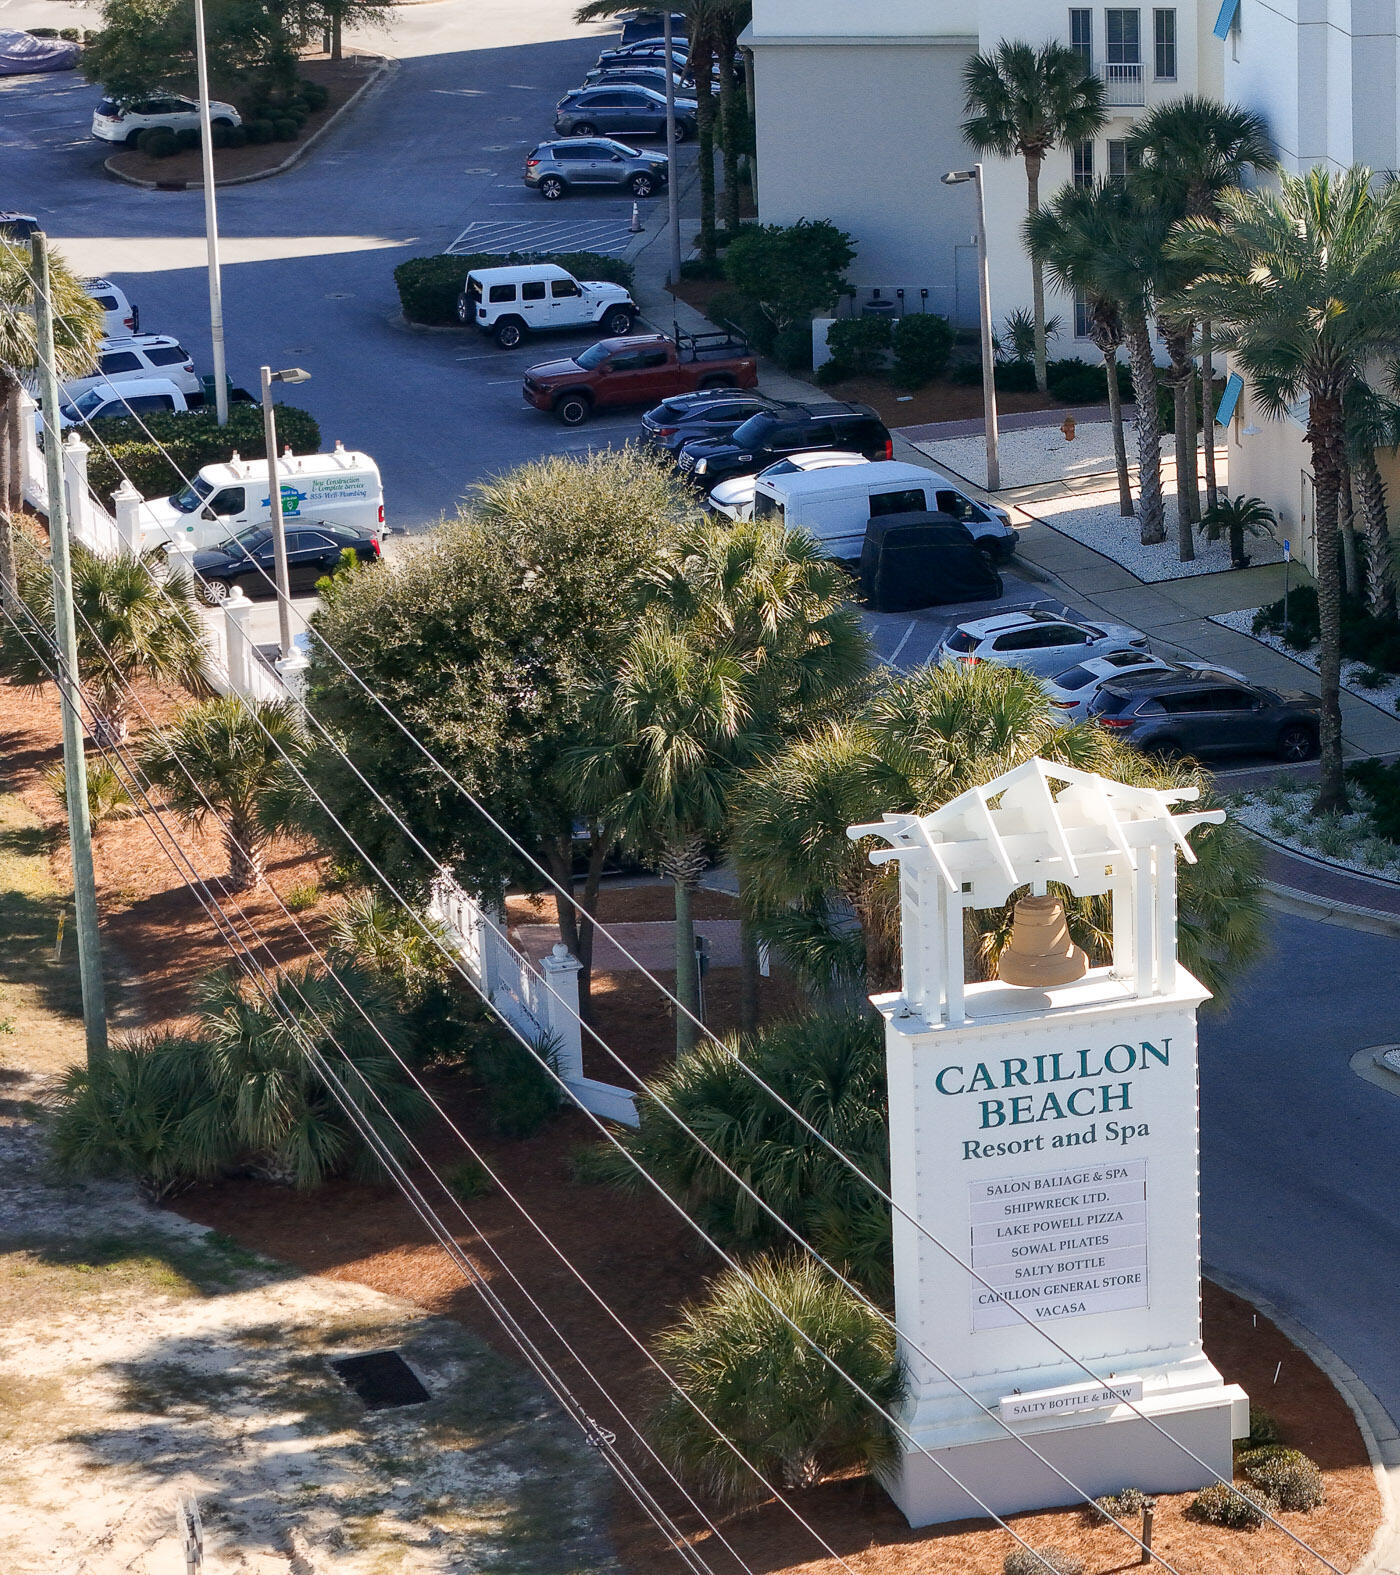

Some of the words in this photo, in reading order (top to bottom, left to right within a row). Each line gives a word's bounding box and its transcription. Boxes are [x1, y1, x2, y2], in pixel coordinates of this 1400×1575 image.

[935, 1038, 1172, 1096] CARILLON
[978, 1081, 1133, 1130] BEACH
[962, 1134, 1044, 1160] Resort
[1051, 1123, 1096, 1149] and
[1105, 1121, 1150, 1146] Spa
[987, 1180, 1031, 1195] SALON
[1034, 1173, 1090, 1190] BALIAGE
[1092, 1171, 1103, 1182] &
[1105, 1168, 1129, 1179] SPA
[1004, 1195, 1079, 1215] SHIPWRECK
[1082, 1192, 1110, 1204] LTD.
[997, 1224, 1030, 1238] LAKE
[1033, 1217, 1084, 1233] POWELL
[1087, 1211, 1124, 1225] PIZZA
[1011, 1243, 1056, 1257] SOWAL
[1059, 1235, 1109, 1251] PILATES
[1015, 1264, 1055, 1278] SALTY
[1057, 1257, 1106, 1273] BOTTLE
[978, 1287, 1041, 1305] CARILLON
[1043, 1279, 1099, 1295] GENERAL
[1102, 1273, 1141, 1288] STORE
[1035, 1302, 1086, 1317] VACASA
[1013, 1401, 1047, 1414] SALTY
[1049, 1395, 1089, 1409] BOTTLE
